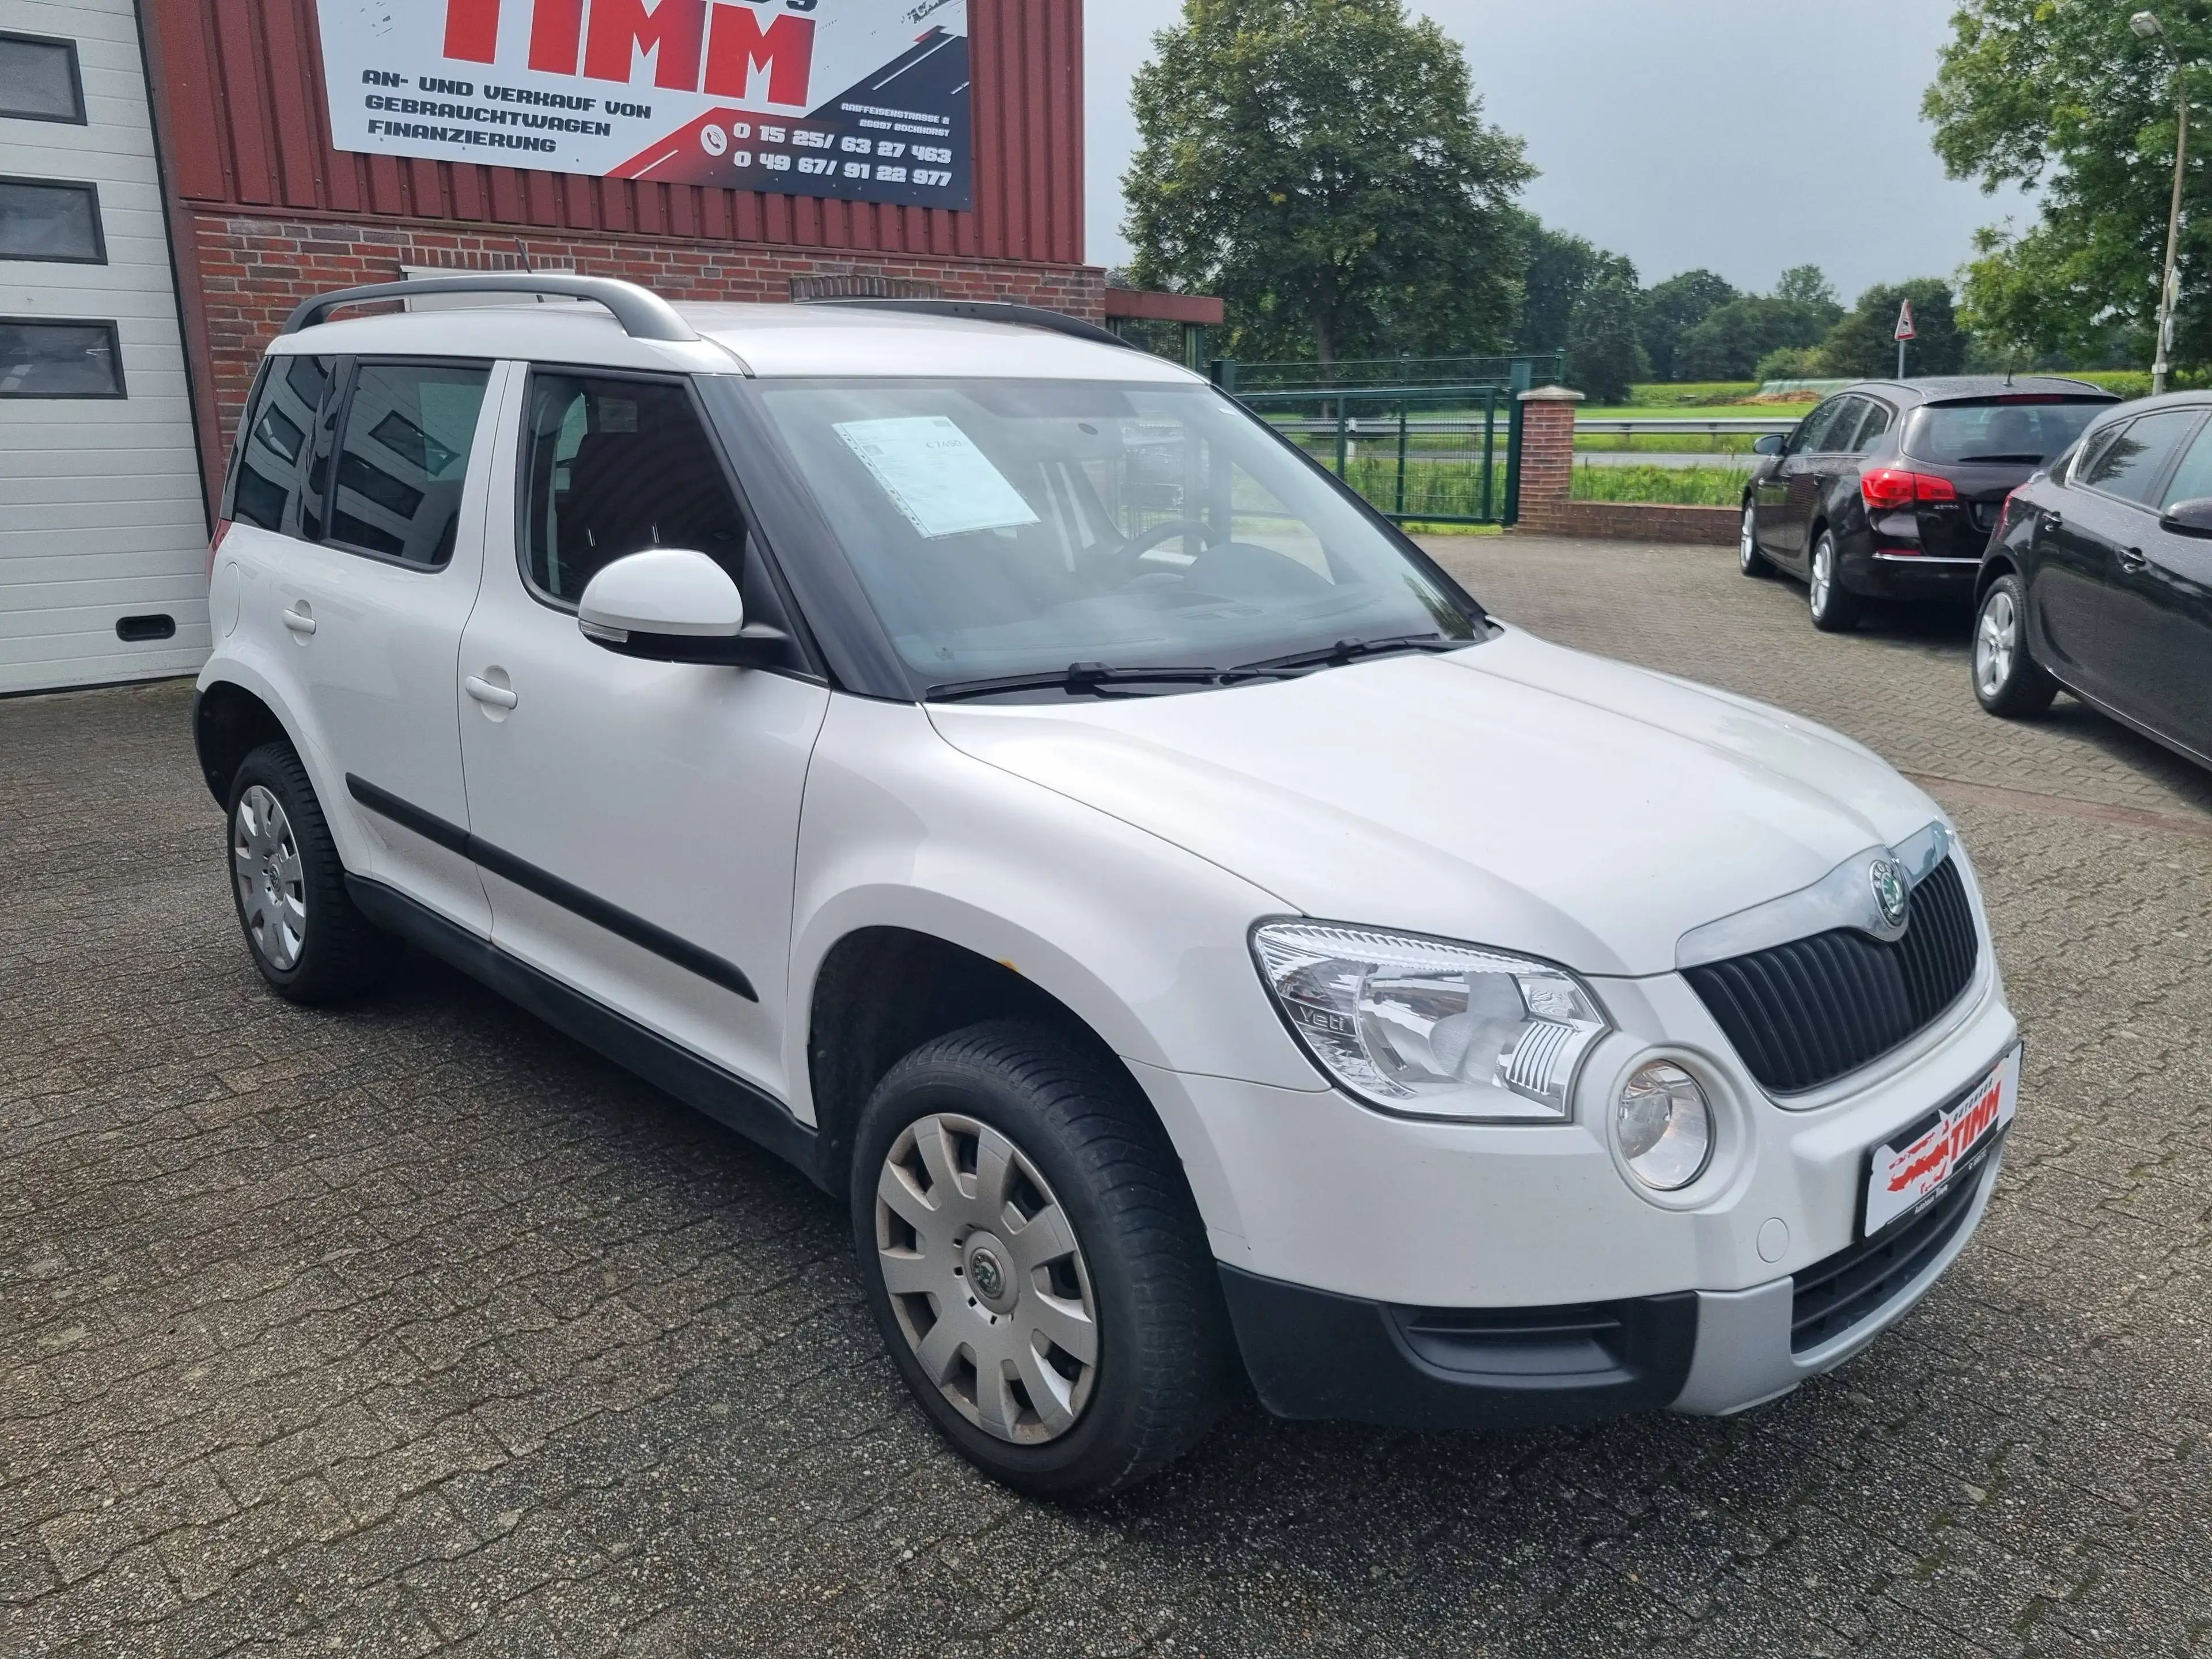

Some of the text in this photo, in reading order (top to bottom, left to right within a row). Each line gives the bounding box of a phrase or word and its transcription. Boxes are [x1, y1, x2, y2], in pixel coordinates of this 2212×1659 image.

[362, 69, 652, 119] AN- UND VERKAUF VON
[842, 103, 950, 124] RAIFFEISENSTRASSE 2
[365, 94, 611, 137] GEBRAUCHTWAGEN
[368, 119, 556, 153] FINANZIERUNG
[733, 122, 952, 164] 0 15 25/ 63 27 463
[734, 150, 952, 187] 0 49 67/ 91 22 977
[1300, 1006, 1344, 1032] Yeti
[1950, 1078, 2002, 1163] TIMM
